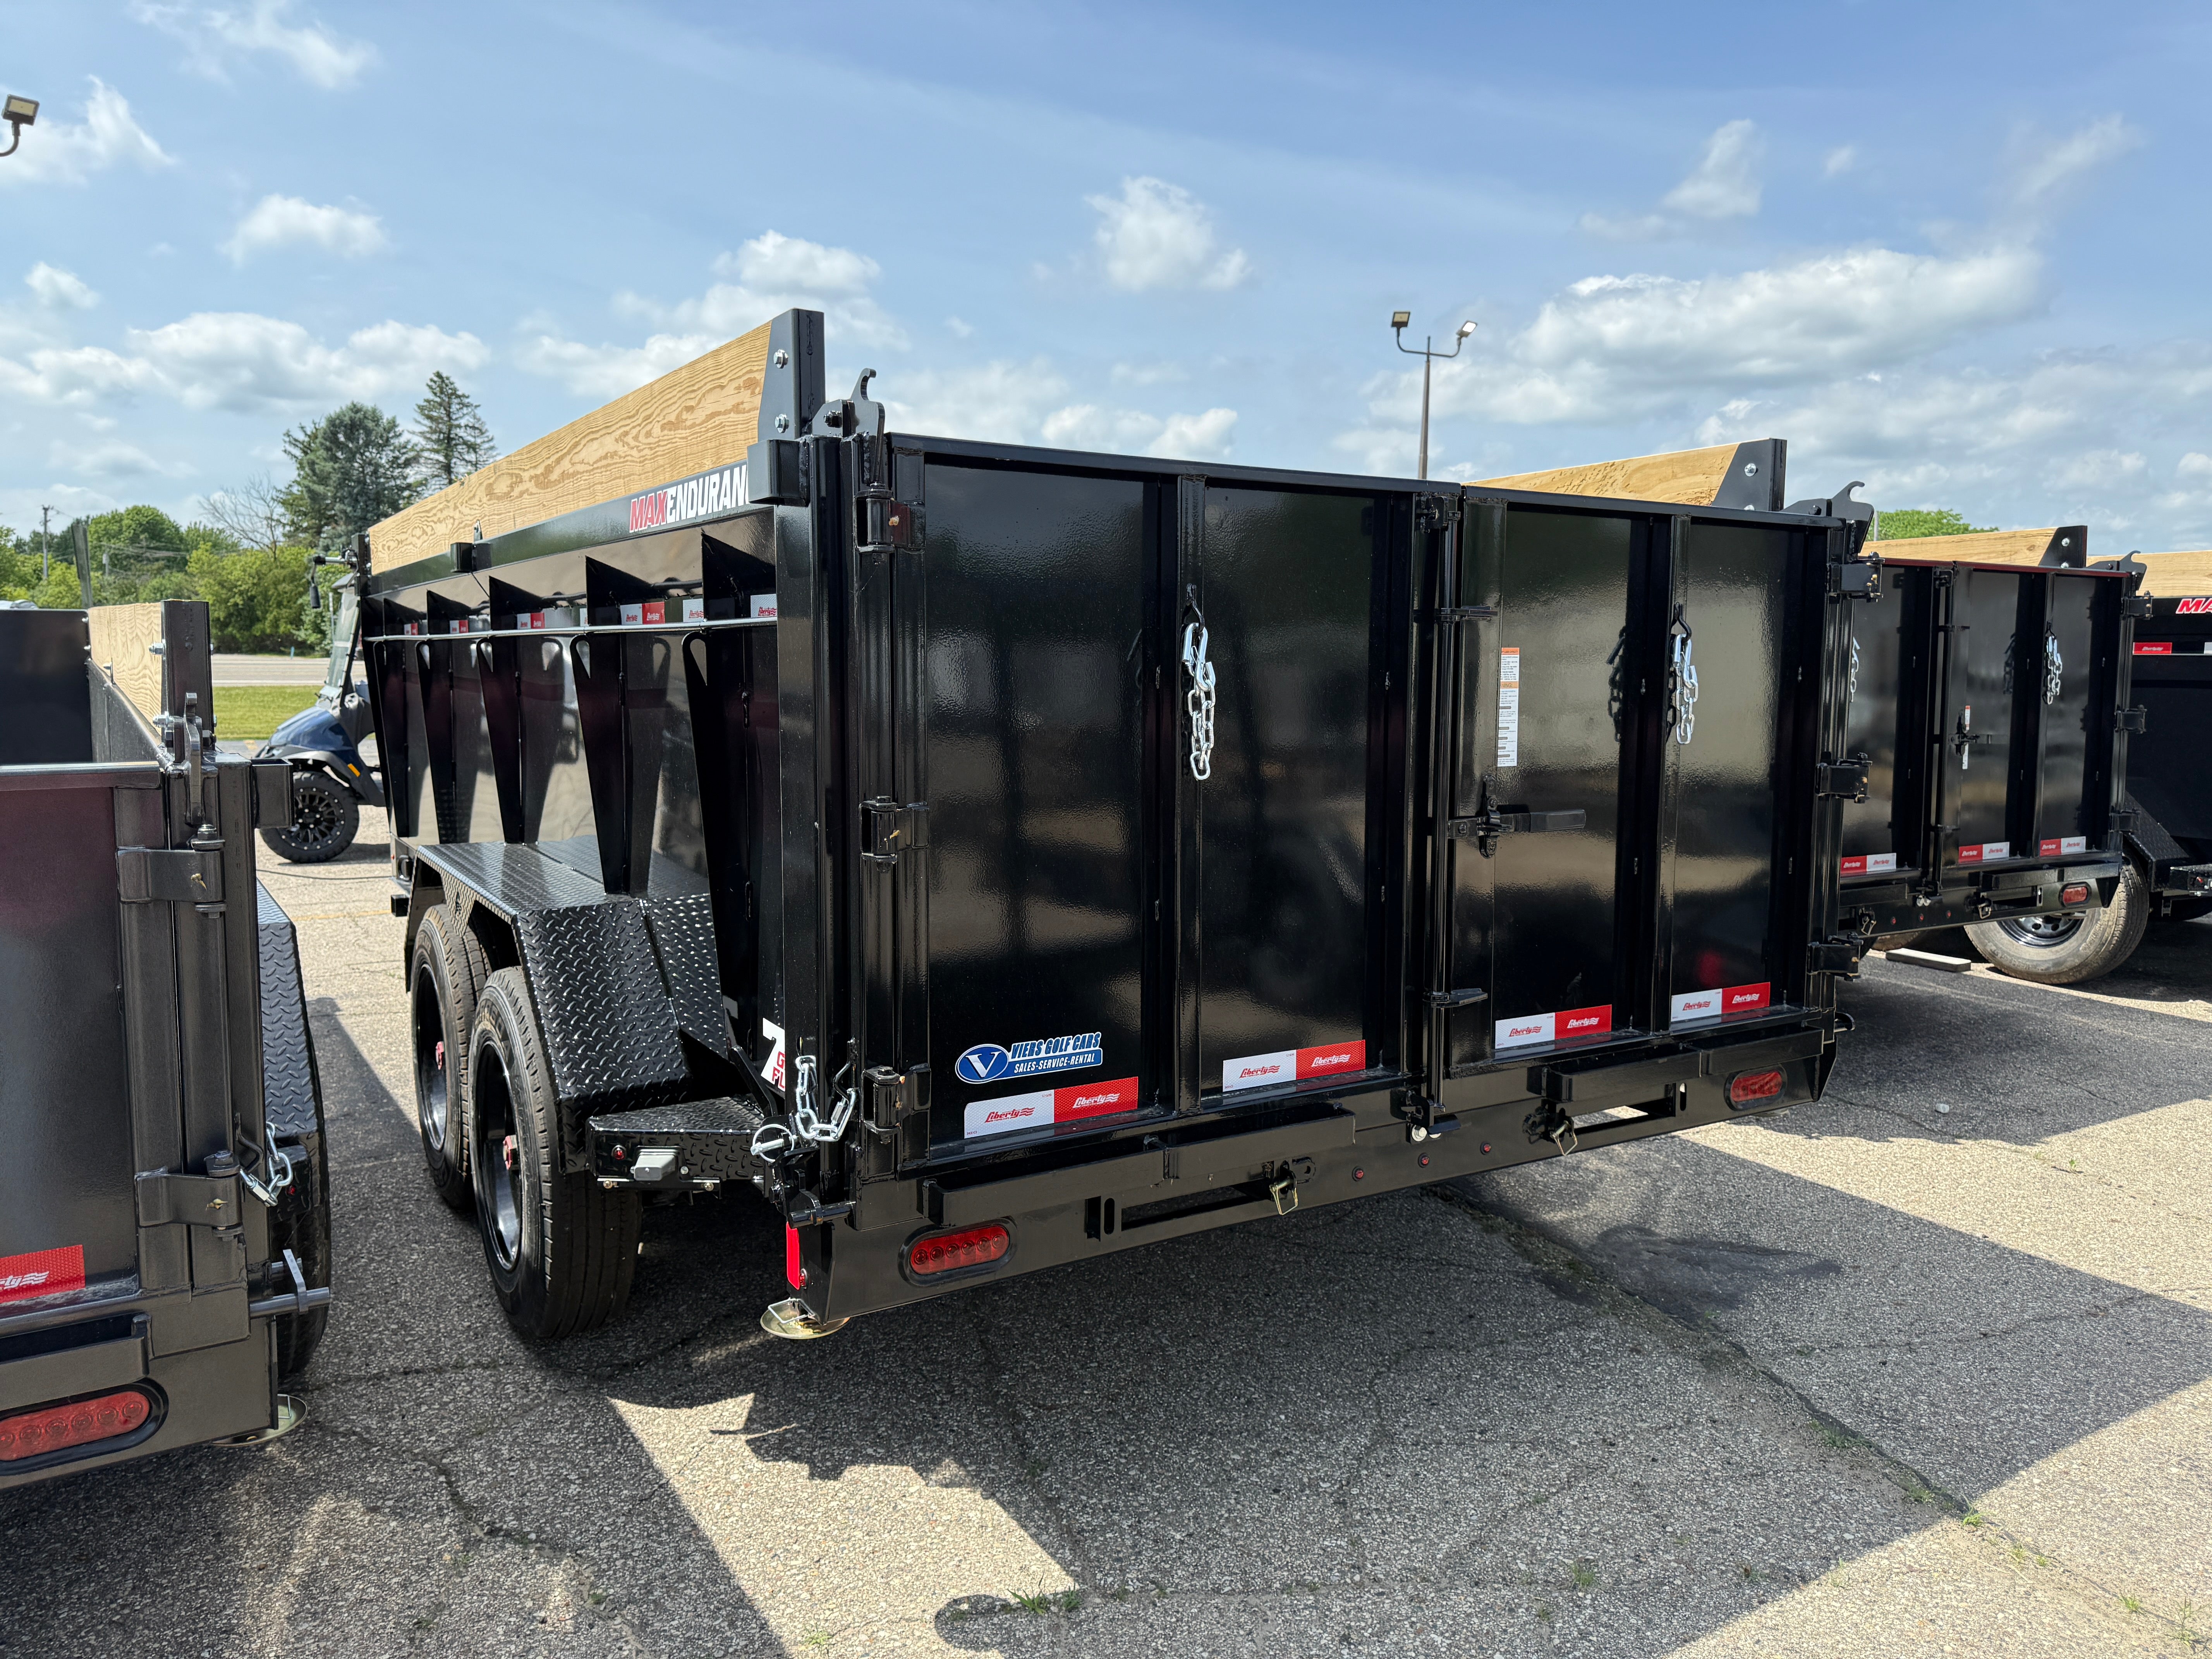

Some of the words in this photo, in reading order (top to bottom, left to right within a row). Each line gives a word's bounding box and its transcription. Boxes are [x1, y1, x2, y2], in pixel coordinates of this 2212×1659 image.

[630, 465, 749, 533] MAXENDURAN
[1567, 1018, 1590, 1029] Liberty
[1509, 1027, 1532, 1037] Liberty
[1011, 1041, 1043, 1059] VIERS
[1045, 1037, 1072, 1055] GOLF
[1072, 1033, 1101, 1051] CARS
[966, 1051, 1002, 1078] V
[1014, 1053, 1095, 1073] SALES-SERVICE-RENTAL
[1311, 1055, 1340, 1068] Liberty
[1239, 1066, 1268, 1079] Liberty
[1072, 1095, 1106, 1109] Liberty
[984, 1109, 1021, 1123] Liberty
